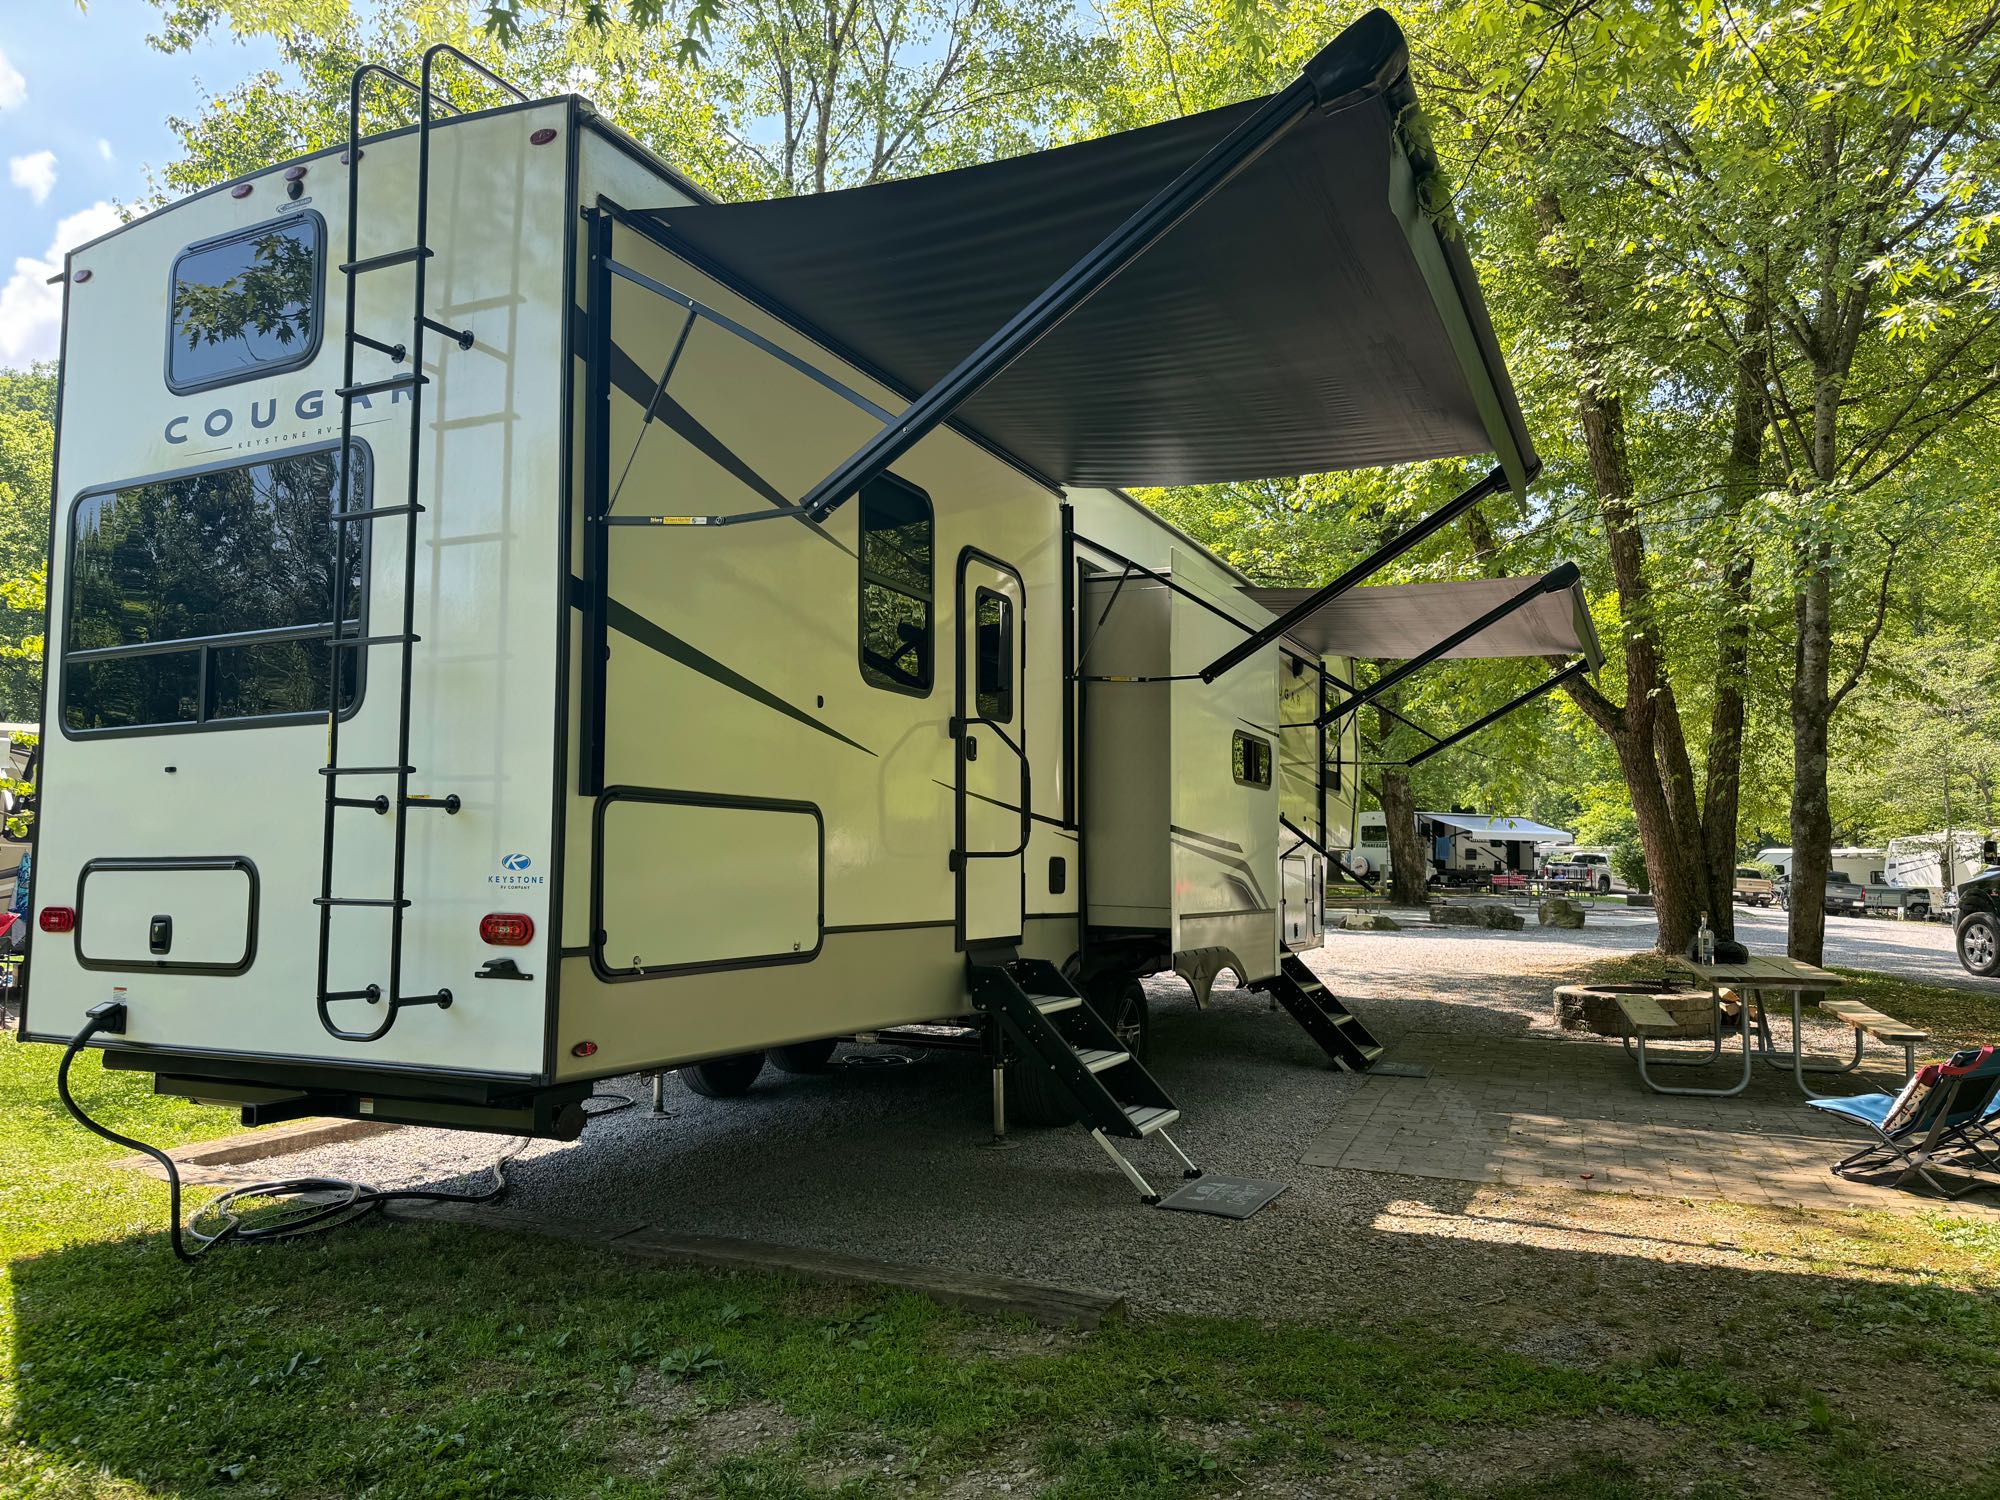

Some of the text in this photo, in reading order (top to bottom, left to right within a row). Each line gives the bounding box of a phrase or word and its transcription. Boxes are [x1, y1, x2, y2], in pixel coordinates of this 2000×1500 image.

[238, 426, 333, 449] KEYSTONE RV
[488, 876, 544, 884] KEYSTONE
